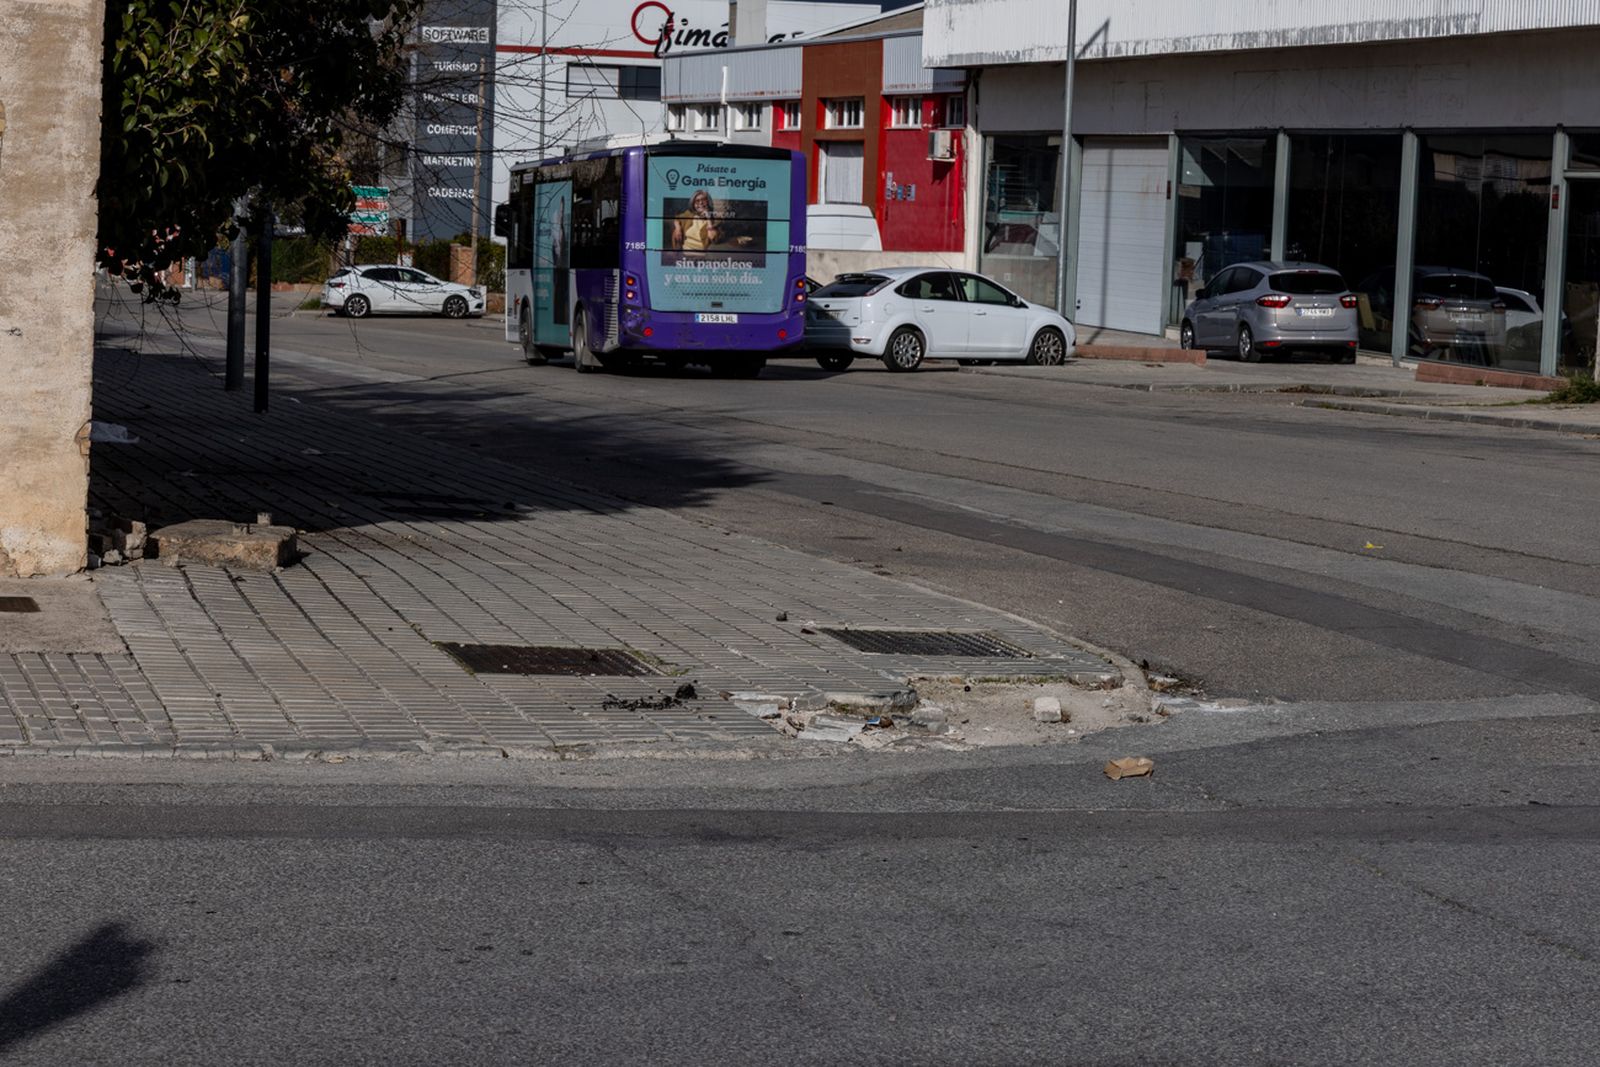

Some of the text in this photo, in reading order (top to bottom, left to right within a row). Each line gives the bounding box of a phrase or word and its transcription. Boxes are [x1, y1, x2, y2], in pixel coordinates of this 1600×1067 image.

[424, 28, 487, 41] SOFTWARE
[433, 61, 478, 72] TURISMO
[696, 163, 729, 174] Pásate
[681, 175, 767, 191] Gana Energía
[428, 187, 475, 199] CADENAS
[625, 242, 646, 250] 7185
[675, 257, 753, 273] sin papeleos
[664, 273, 763, 286] y en un solo día.
[701, 314, 720, 322] 2158
